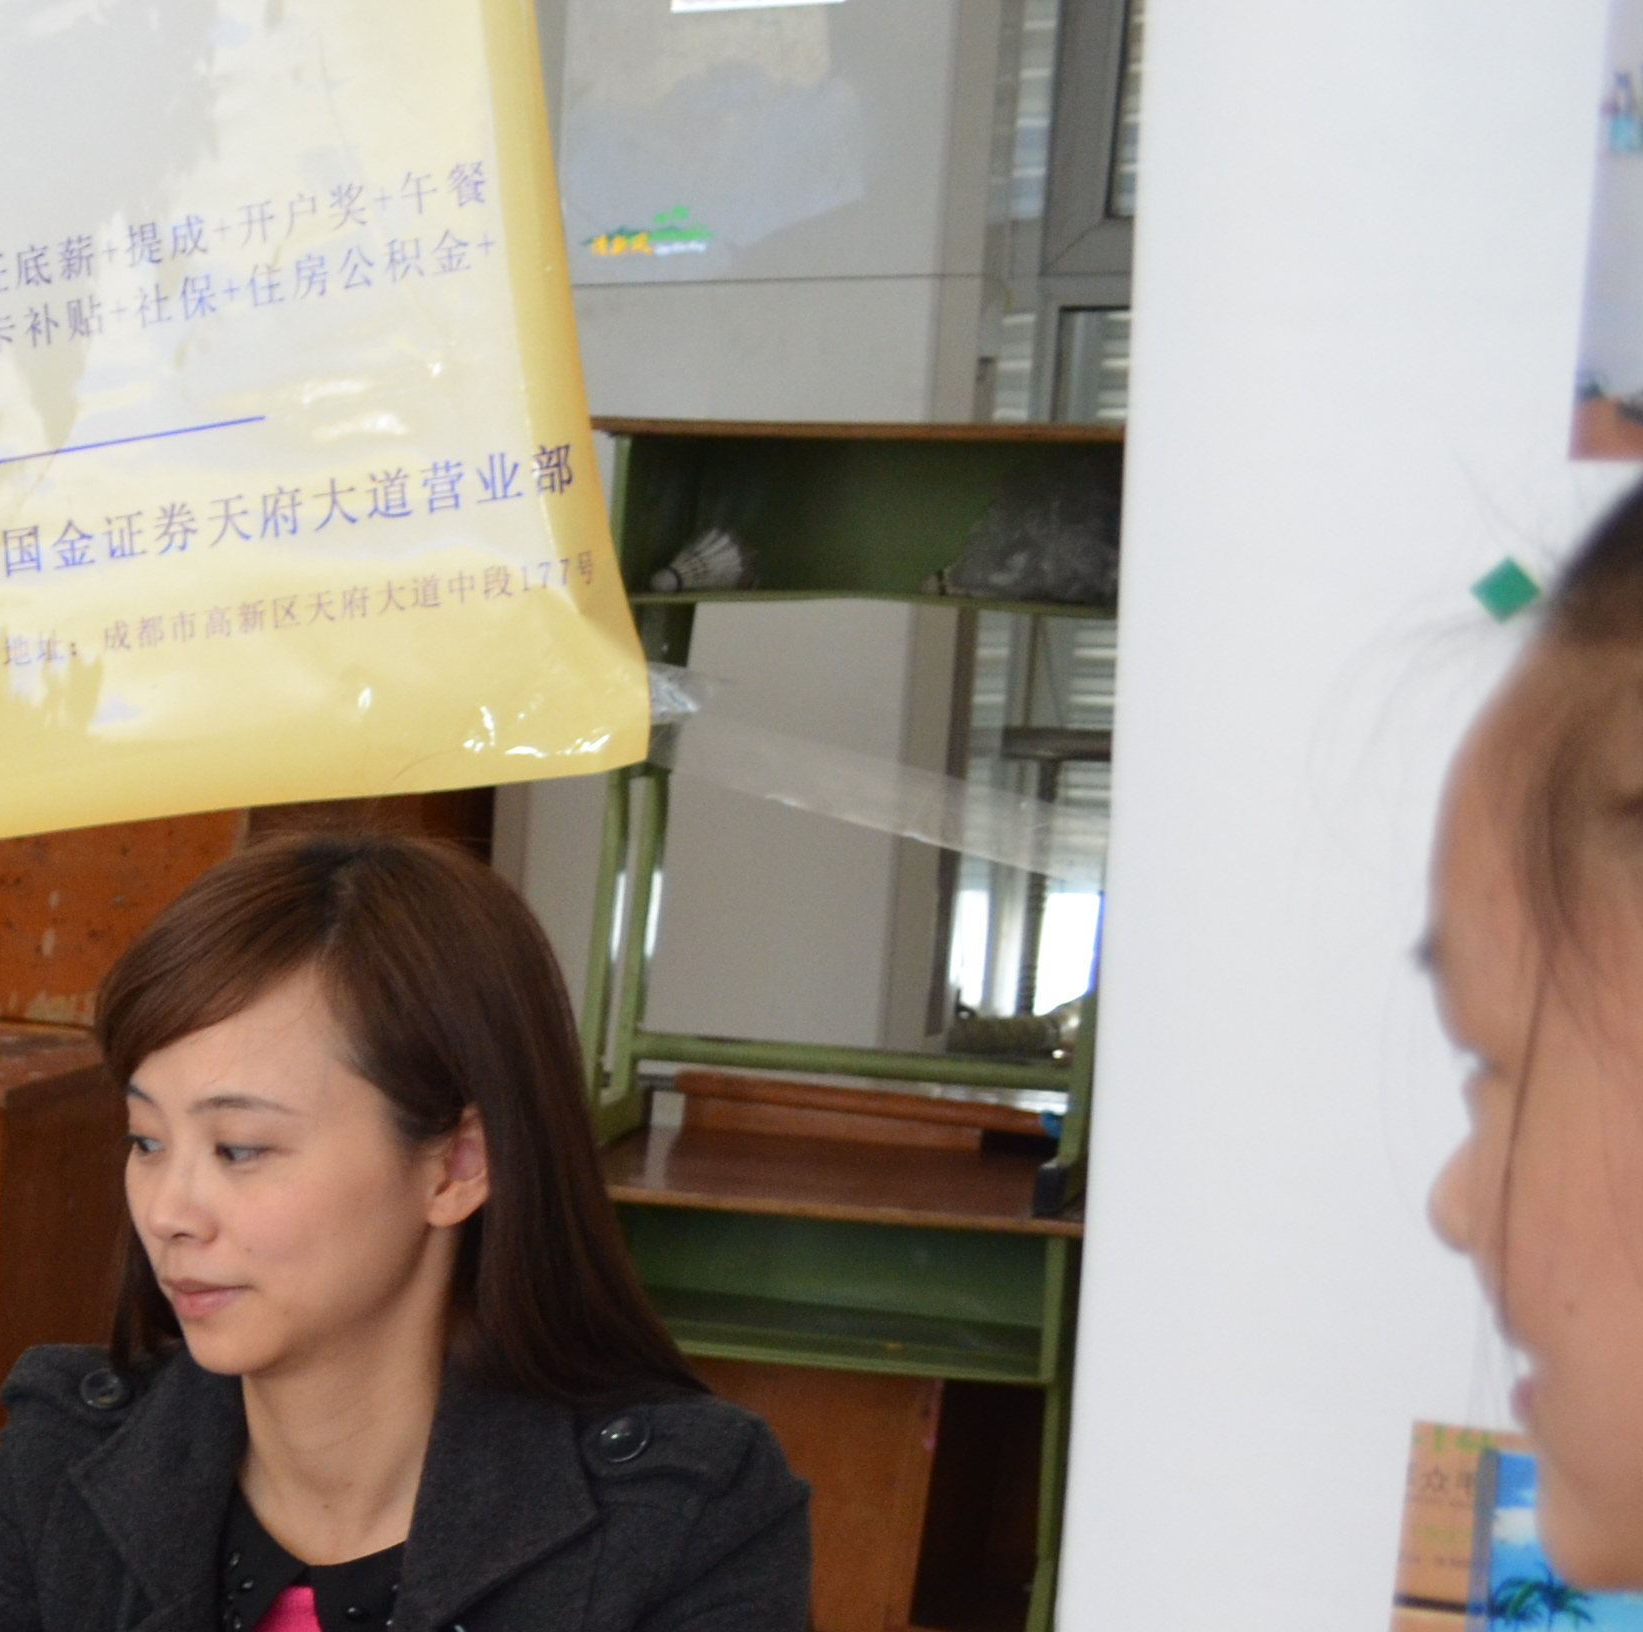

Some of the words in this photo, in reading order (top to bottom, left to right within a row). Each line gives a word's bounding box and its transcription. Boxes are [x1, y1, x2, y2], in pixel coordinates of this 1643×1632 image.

[2, 442, 574, 578] 国金证券天府大道营业部
